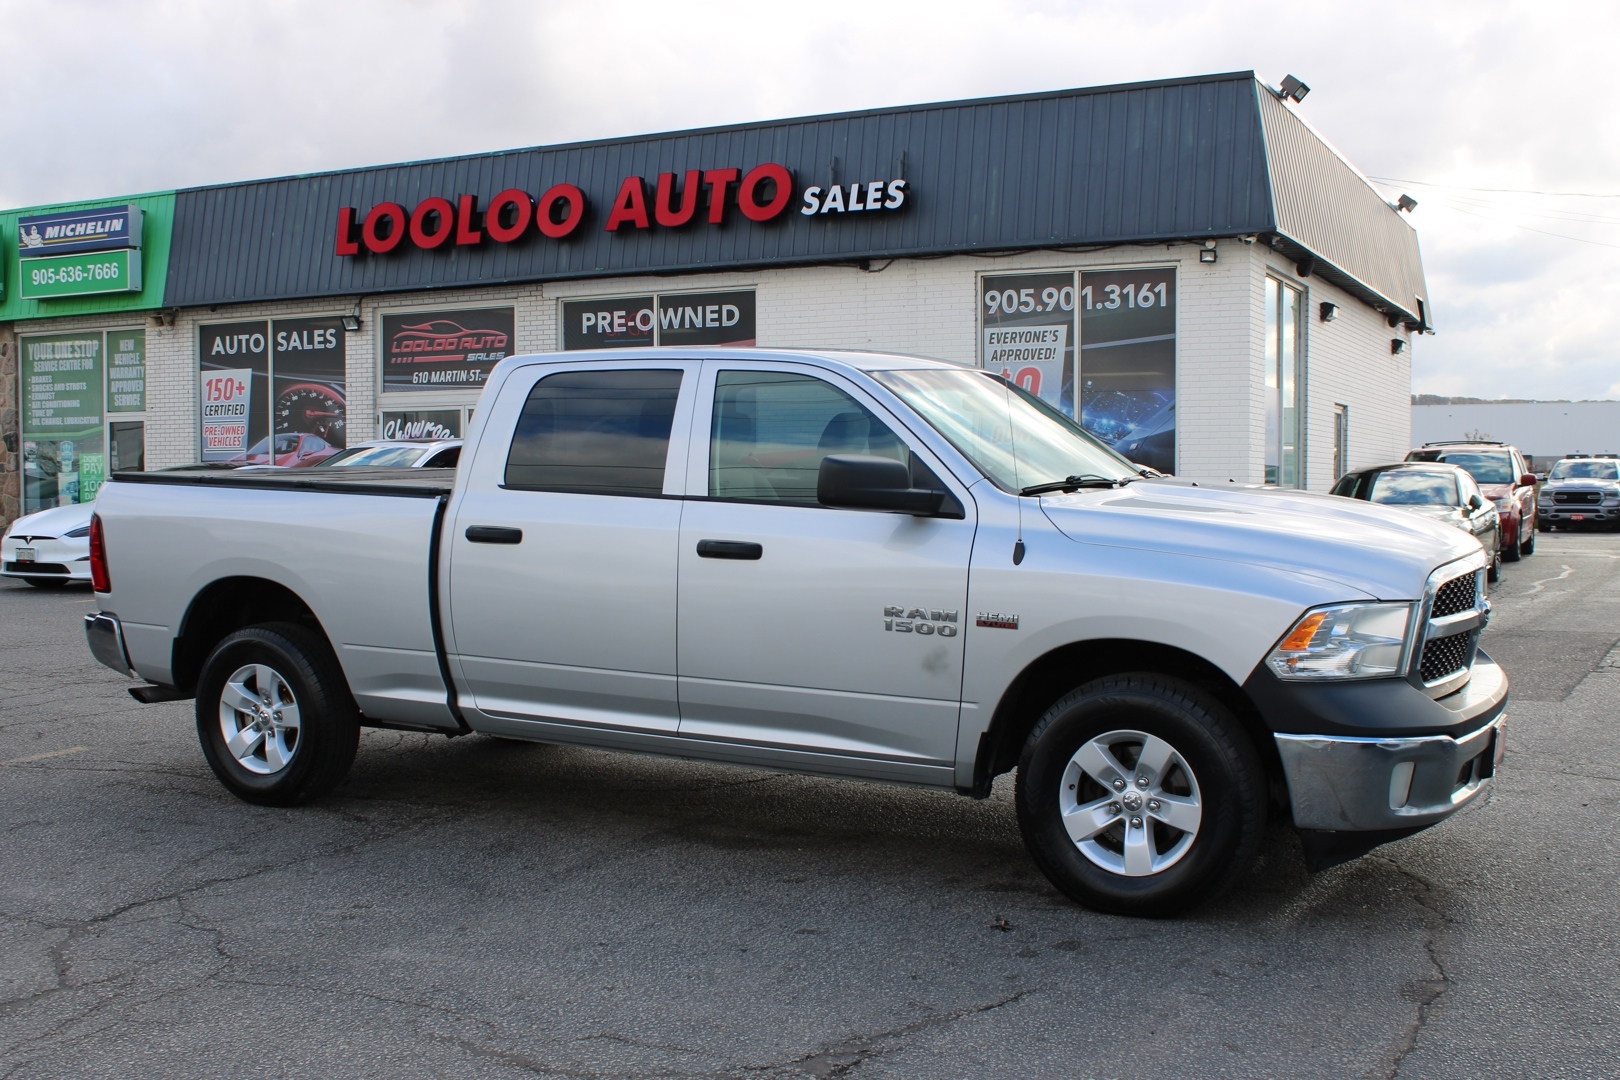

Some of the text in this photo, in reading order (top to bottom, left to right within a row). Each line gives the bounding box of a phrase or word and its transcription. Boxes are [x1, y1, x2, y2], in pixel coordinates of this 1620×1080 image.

[336, 162, 906, 256] LOOLOO AUTO SALES
[45, 218, 124, 239] MICHELIN
[32, 262, 119, 285] 905-636-7666
[984, 282, 1167, 314] 905.901.3161
[582, 304, 740, 335] PRE-OWNED
[211, 328, 337, 356] AUTO SALES
[988, 329, 1059, 345] EVERYONE'S
[28, 340, 99, 360] YOUR ONE STOP
[119, 339, 135, 352] NEW
[391, 336, 508, 353] LOOLOO AUTO
[114, 353, 140, 365] VEHICLE
[467, 352, 506, 361] SALES
[990, 347, 1056, 362] APPROVED!
[33, 358, 94, 372] SERVICE CENTRE FOR
[31, 375, 53, 384] BRAKES
[109, 366, 145, 379] WARRANTY
[412, 369, 482, 384] 610 MARTIN ST.
[31, 382, 87, 392] SHOCKS AND STRUTS
[110, 380, 144, 393] APPROVED
[206, 377, 246, 402] 150+
[31, 392, 56, 400] EXHAUST
[114, 393, 141, 407] SERVICE
[41, 399, 80, 408] CONDITIONING
[204, 403, 246, 417] CERTIFIED
[32, 409, 46, 417] TUNE
[63, 416, 100, 425] LUBRICATION
[204, 425, 246, 438] PRE-OWNED
[208, 436, 242, 447] VEHICLES
[83, 455, 103, 463] DON'T
[83, 462, 104, 475] PAY
[884, 605, 958, 623] RAM
[976, 611, 1019, 622] HEMI
[884, 618, 958, 637] 1500
